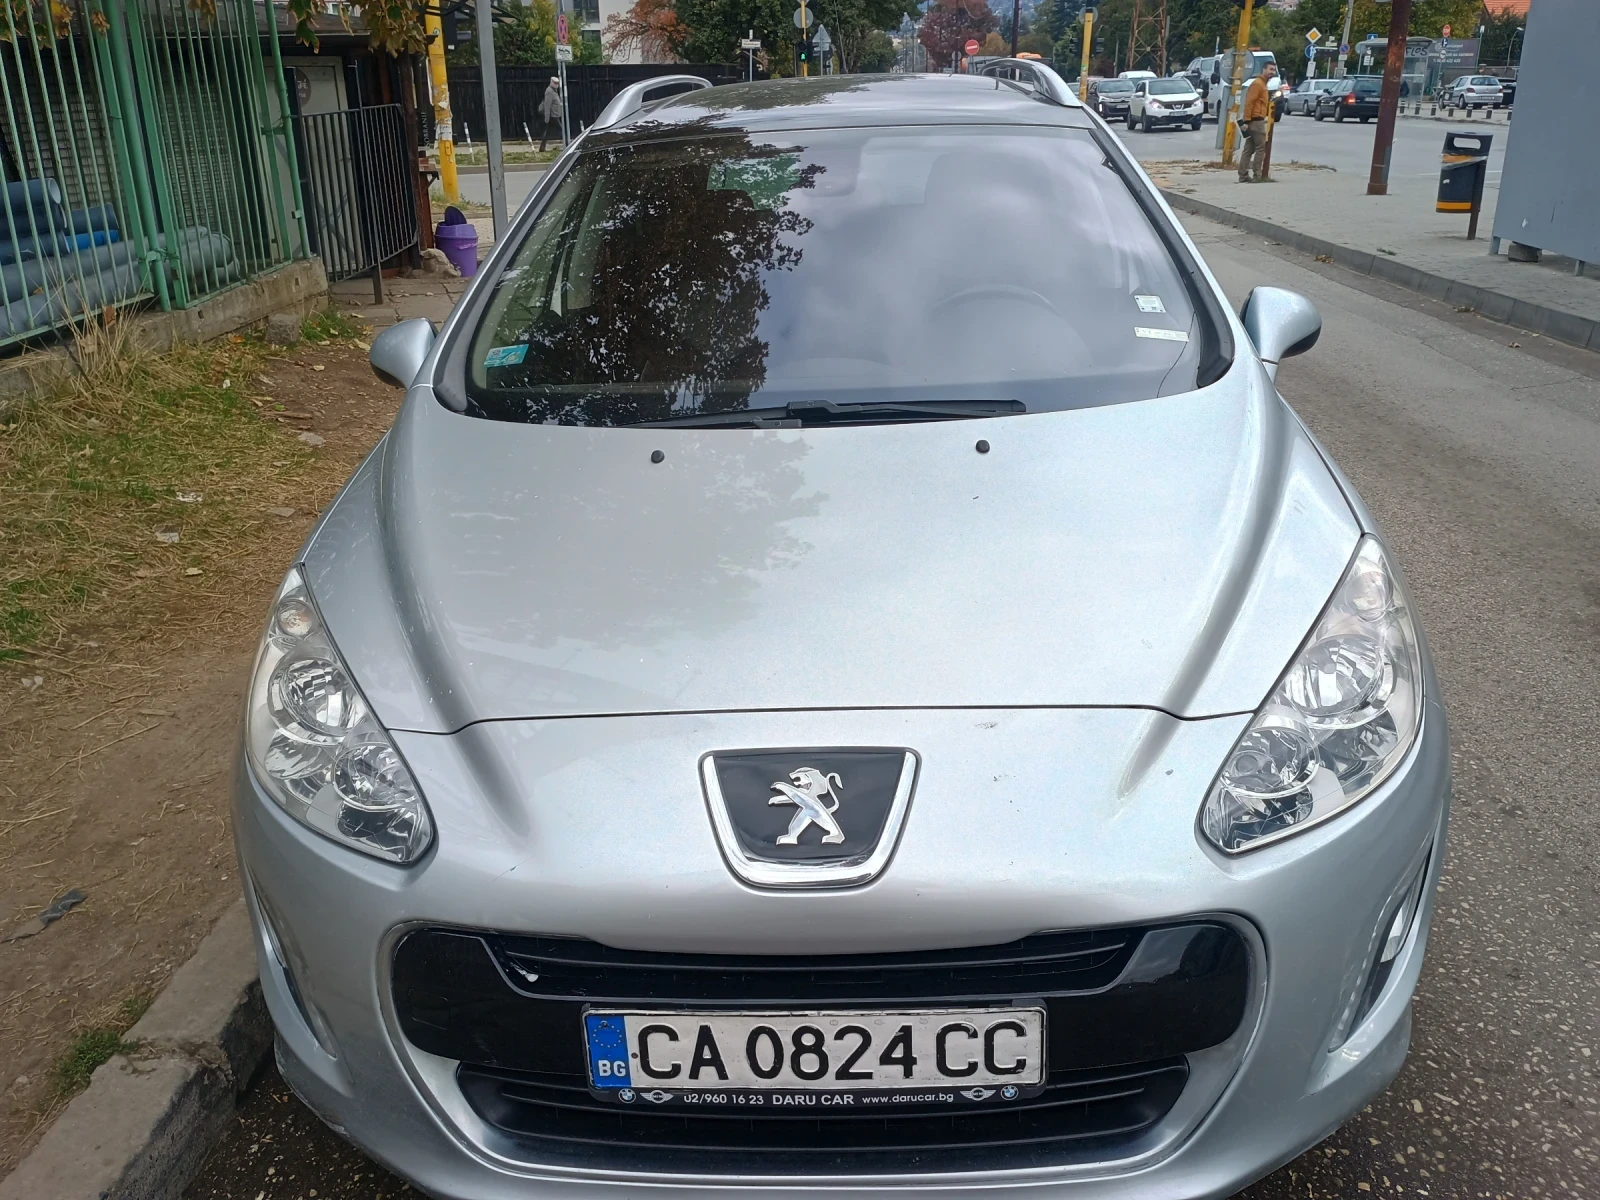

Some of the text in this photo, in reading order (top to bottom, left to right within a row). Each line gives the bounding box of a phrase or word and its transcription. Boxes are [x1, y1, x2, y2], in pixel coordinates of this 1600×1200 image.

[637, 1019, 1028, 1081] CA 0824 CC
[598, 1059, 627, 1077] BG
[683, 1091, 955, 1106] 02/960 16 23 DARU CAR www.darucar.bg
